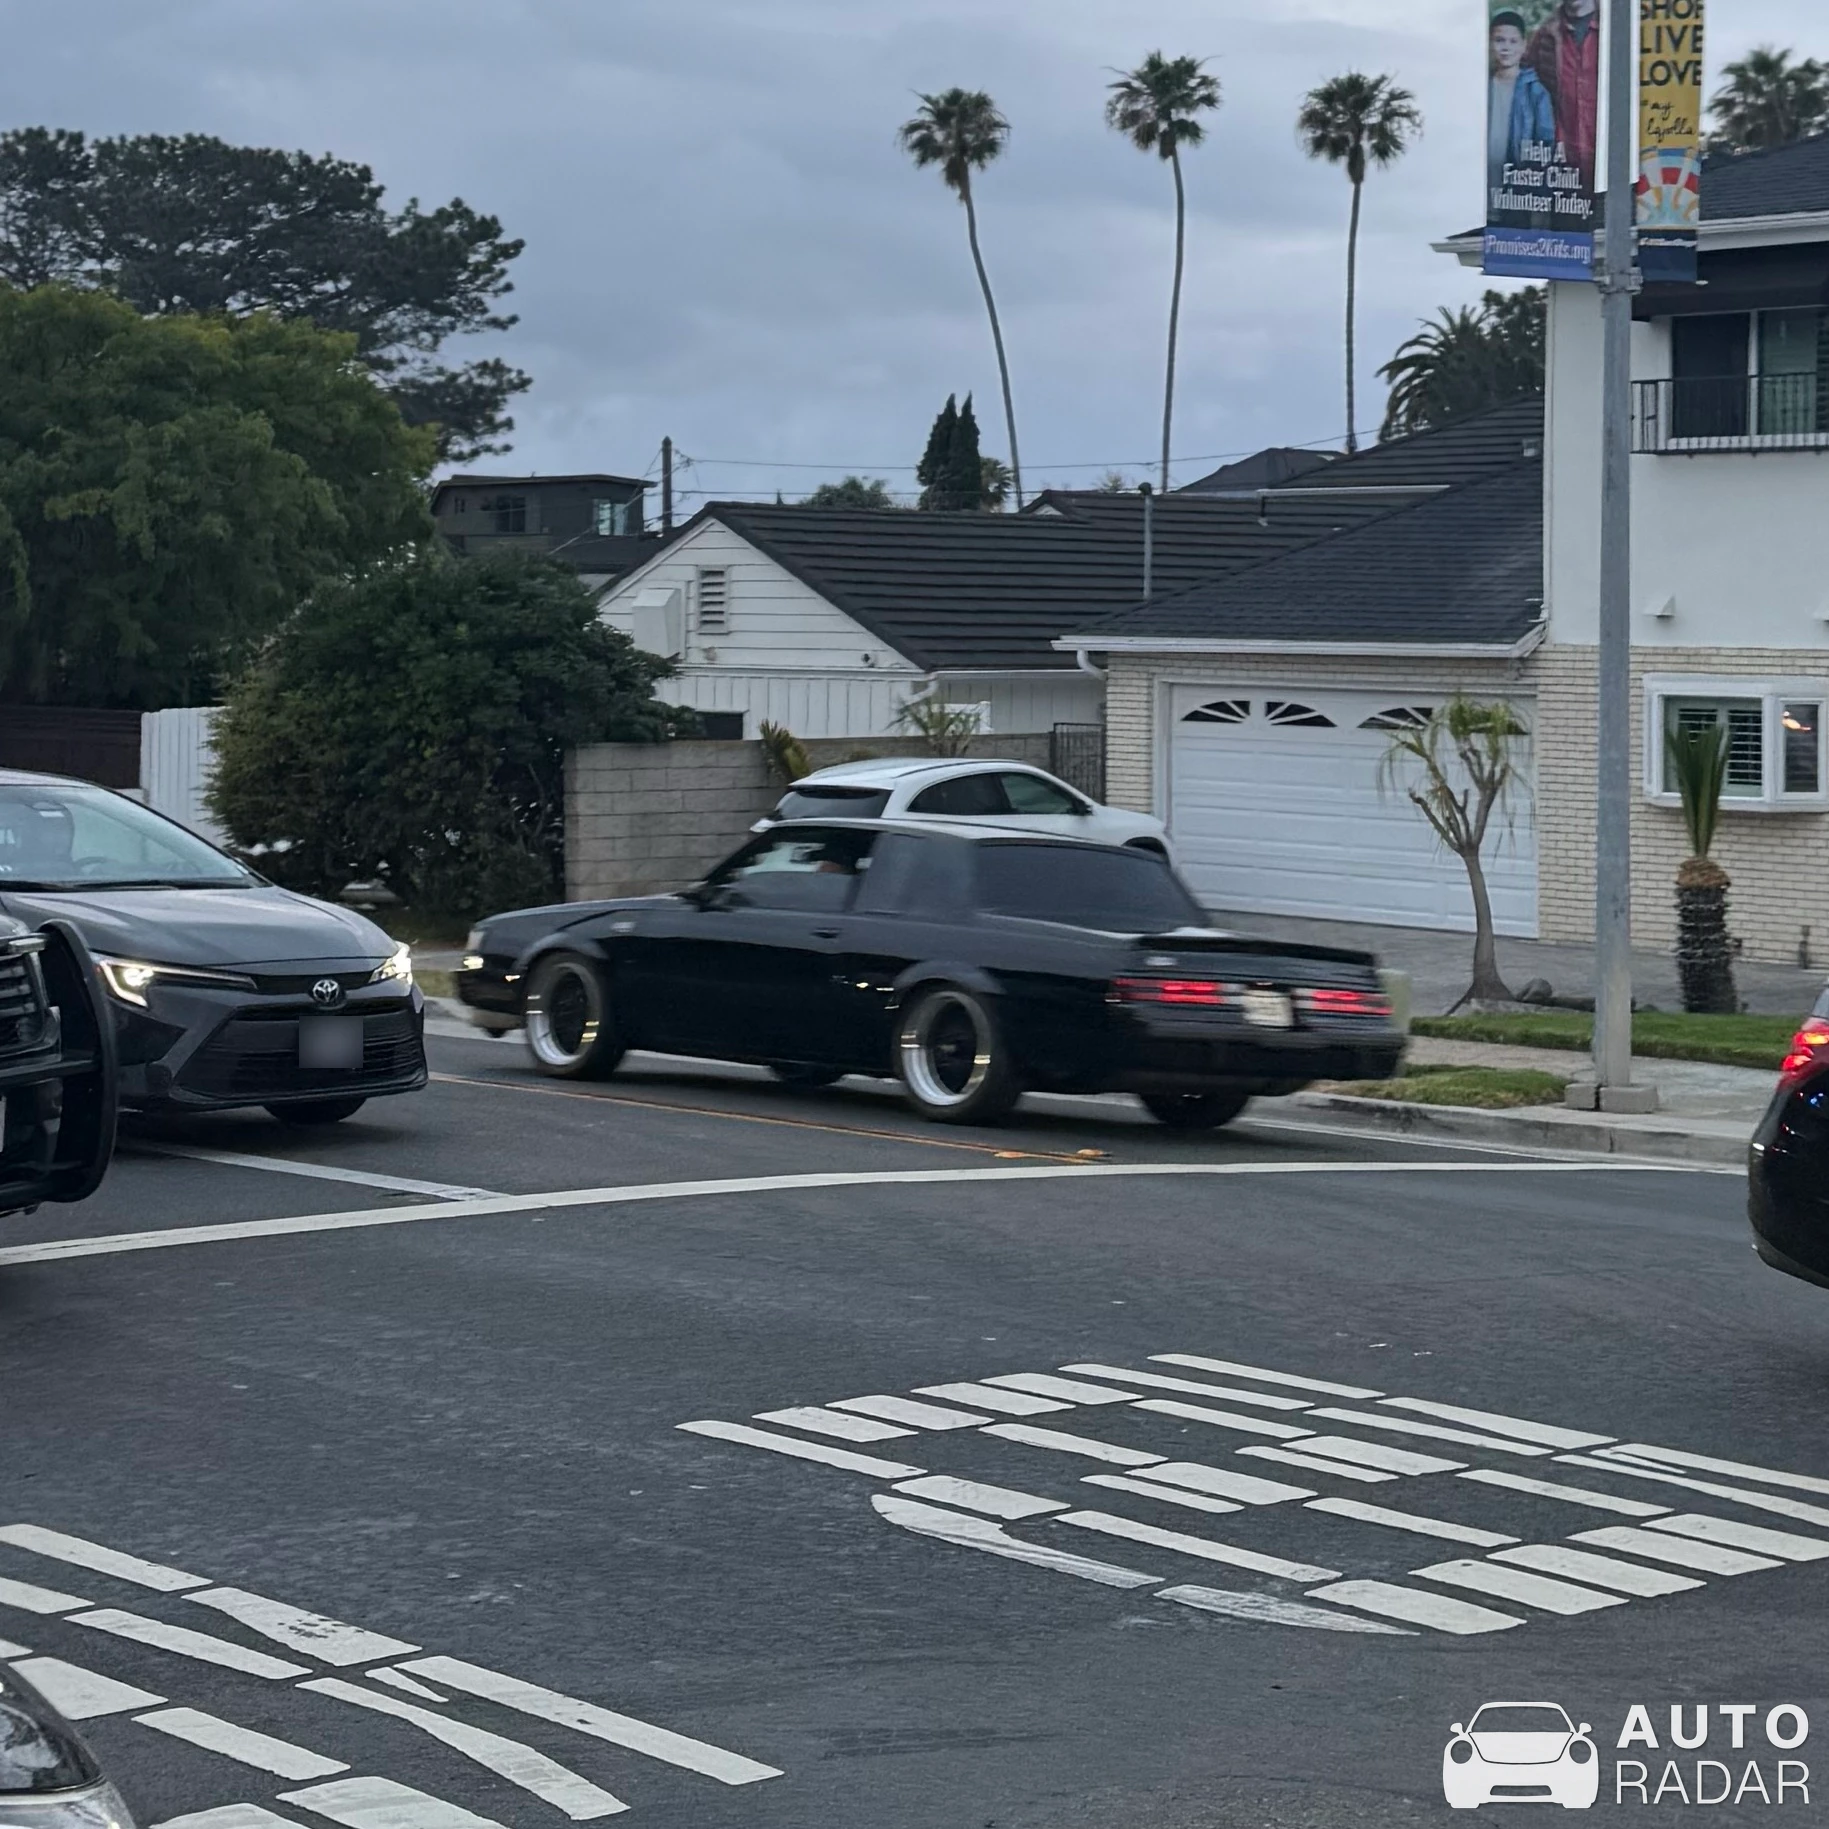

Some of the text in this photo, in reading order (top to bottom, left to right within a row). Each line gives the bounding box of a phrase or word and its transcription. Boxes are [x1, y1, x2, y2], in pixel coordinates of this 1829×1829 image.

[1640, 24, 1703, 54] LIVE
[1640, 60, 1702, 86] LOVE
[1520, 139, 1567, 167] Help A
[1503, 162, 1583, 189] Foster Child.
[1490, 187, 1593, 220] Volunteer Today.
